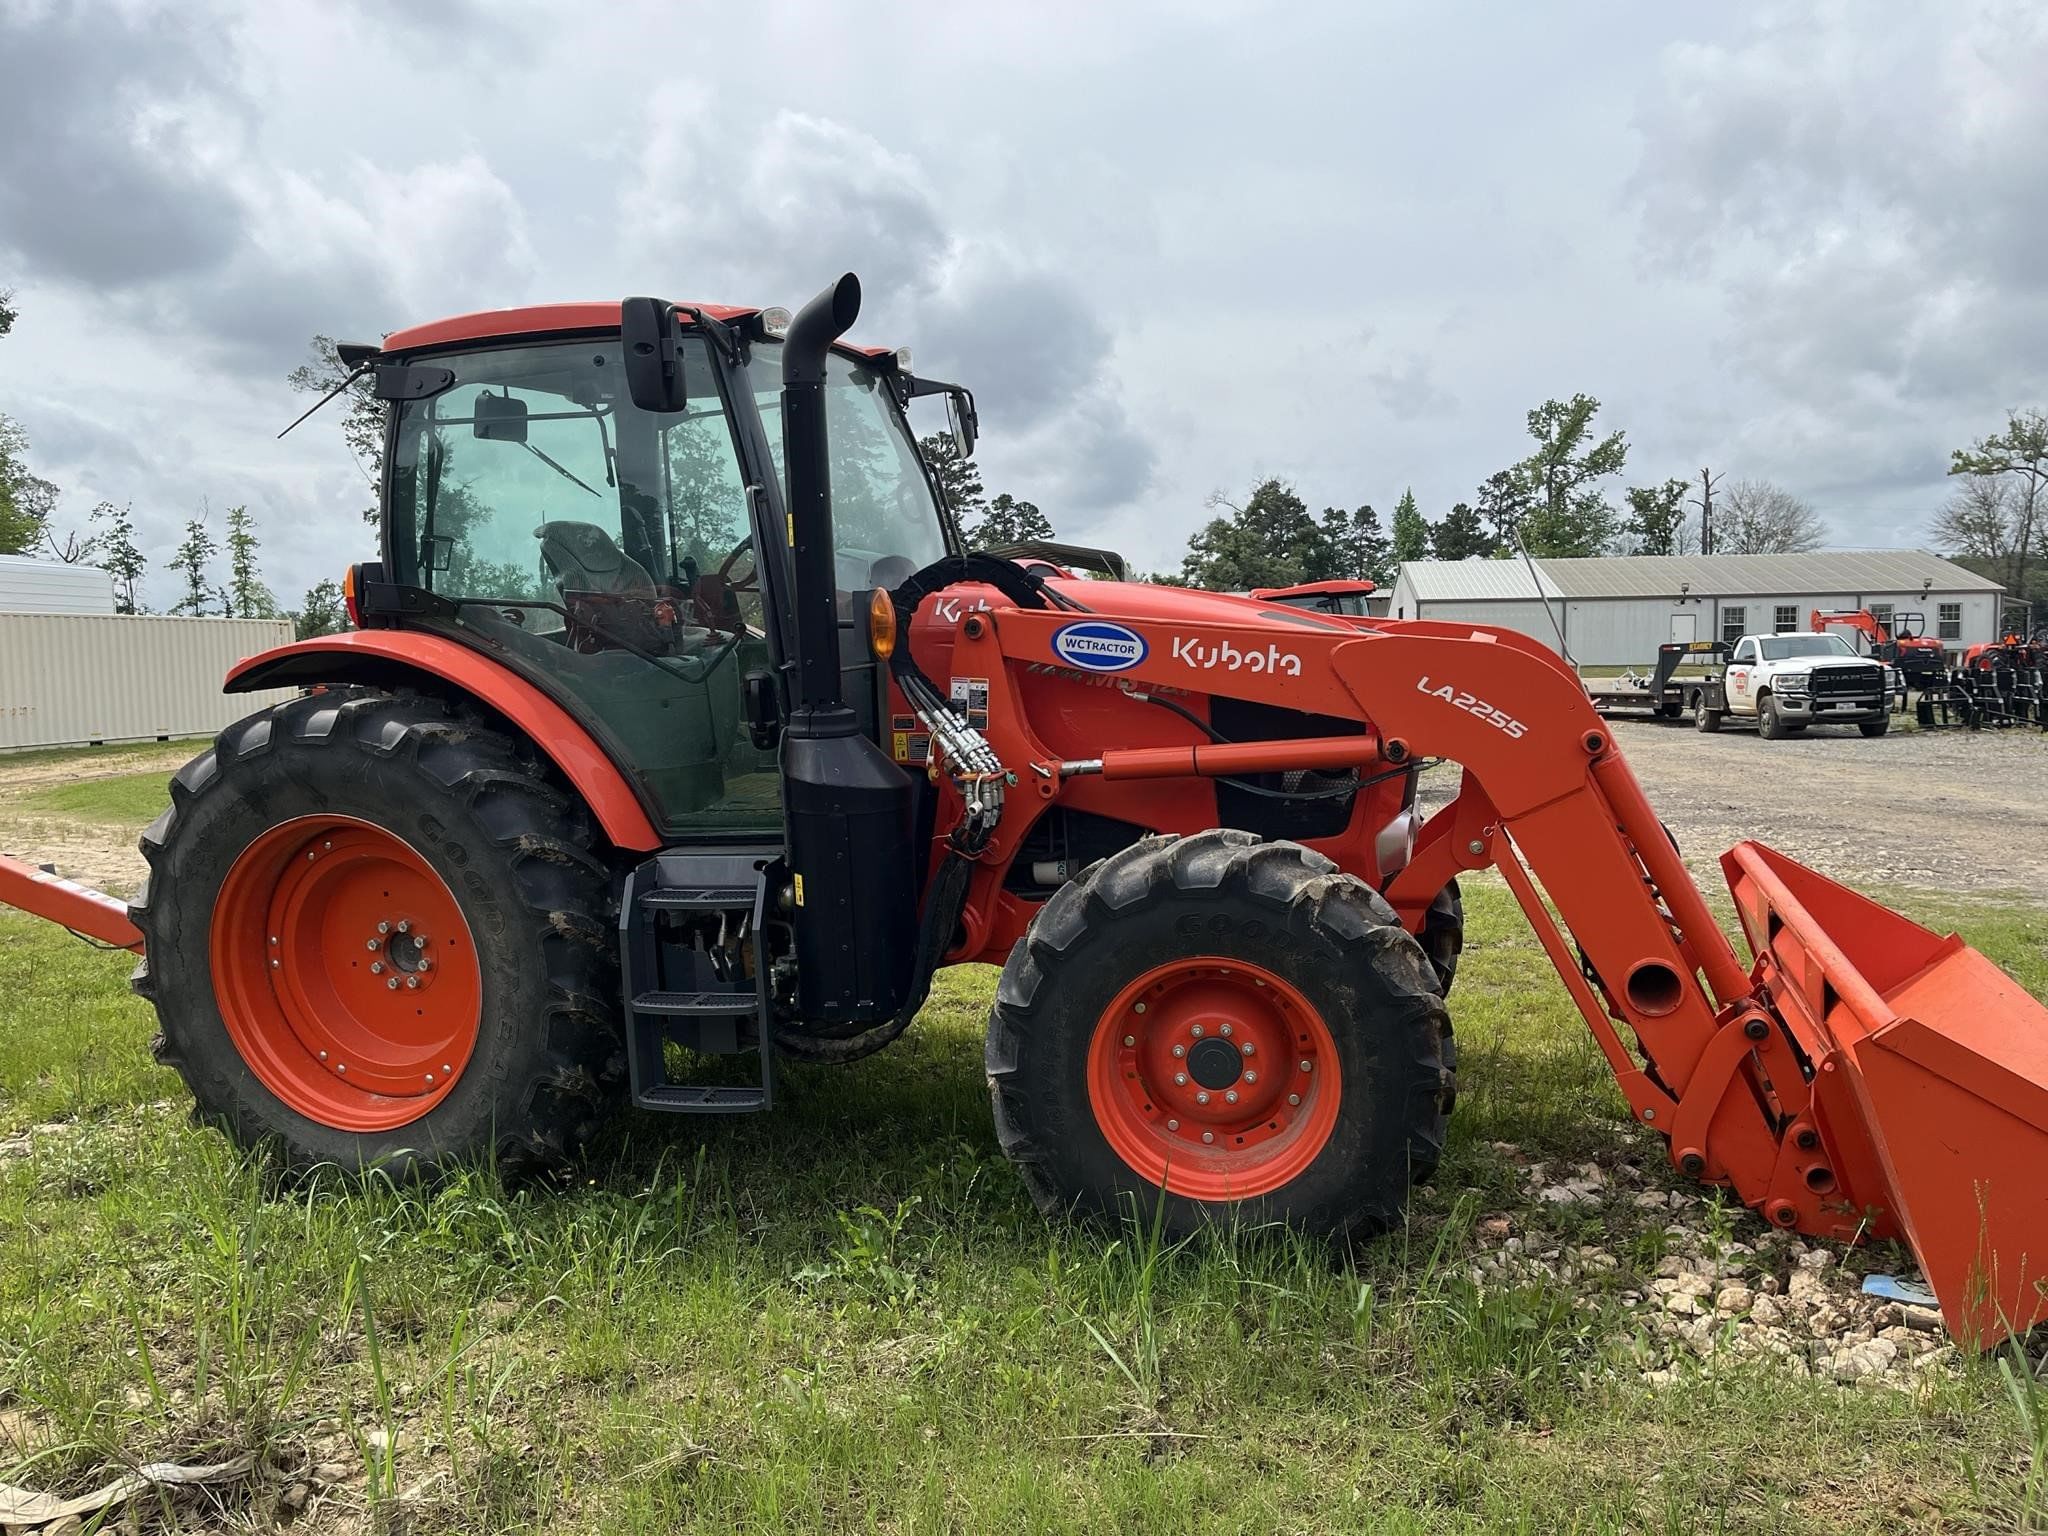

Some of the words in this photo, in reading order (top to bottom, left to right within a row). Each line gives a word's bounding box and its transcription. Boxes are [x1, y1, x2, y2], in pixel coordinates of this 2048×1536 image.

[1065, 637, 1136, 655] WCTRACTOR
[1172, 636, 1301, 676] Kubota
[1416, 676, 1529, 739] LA2255
